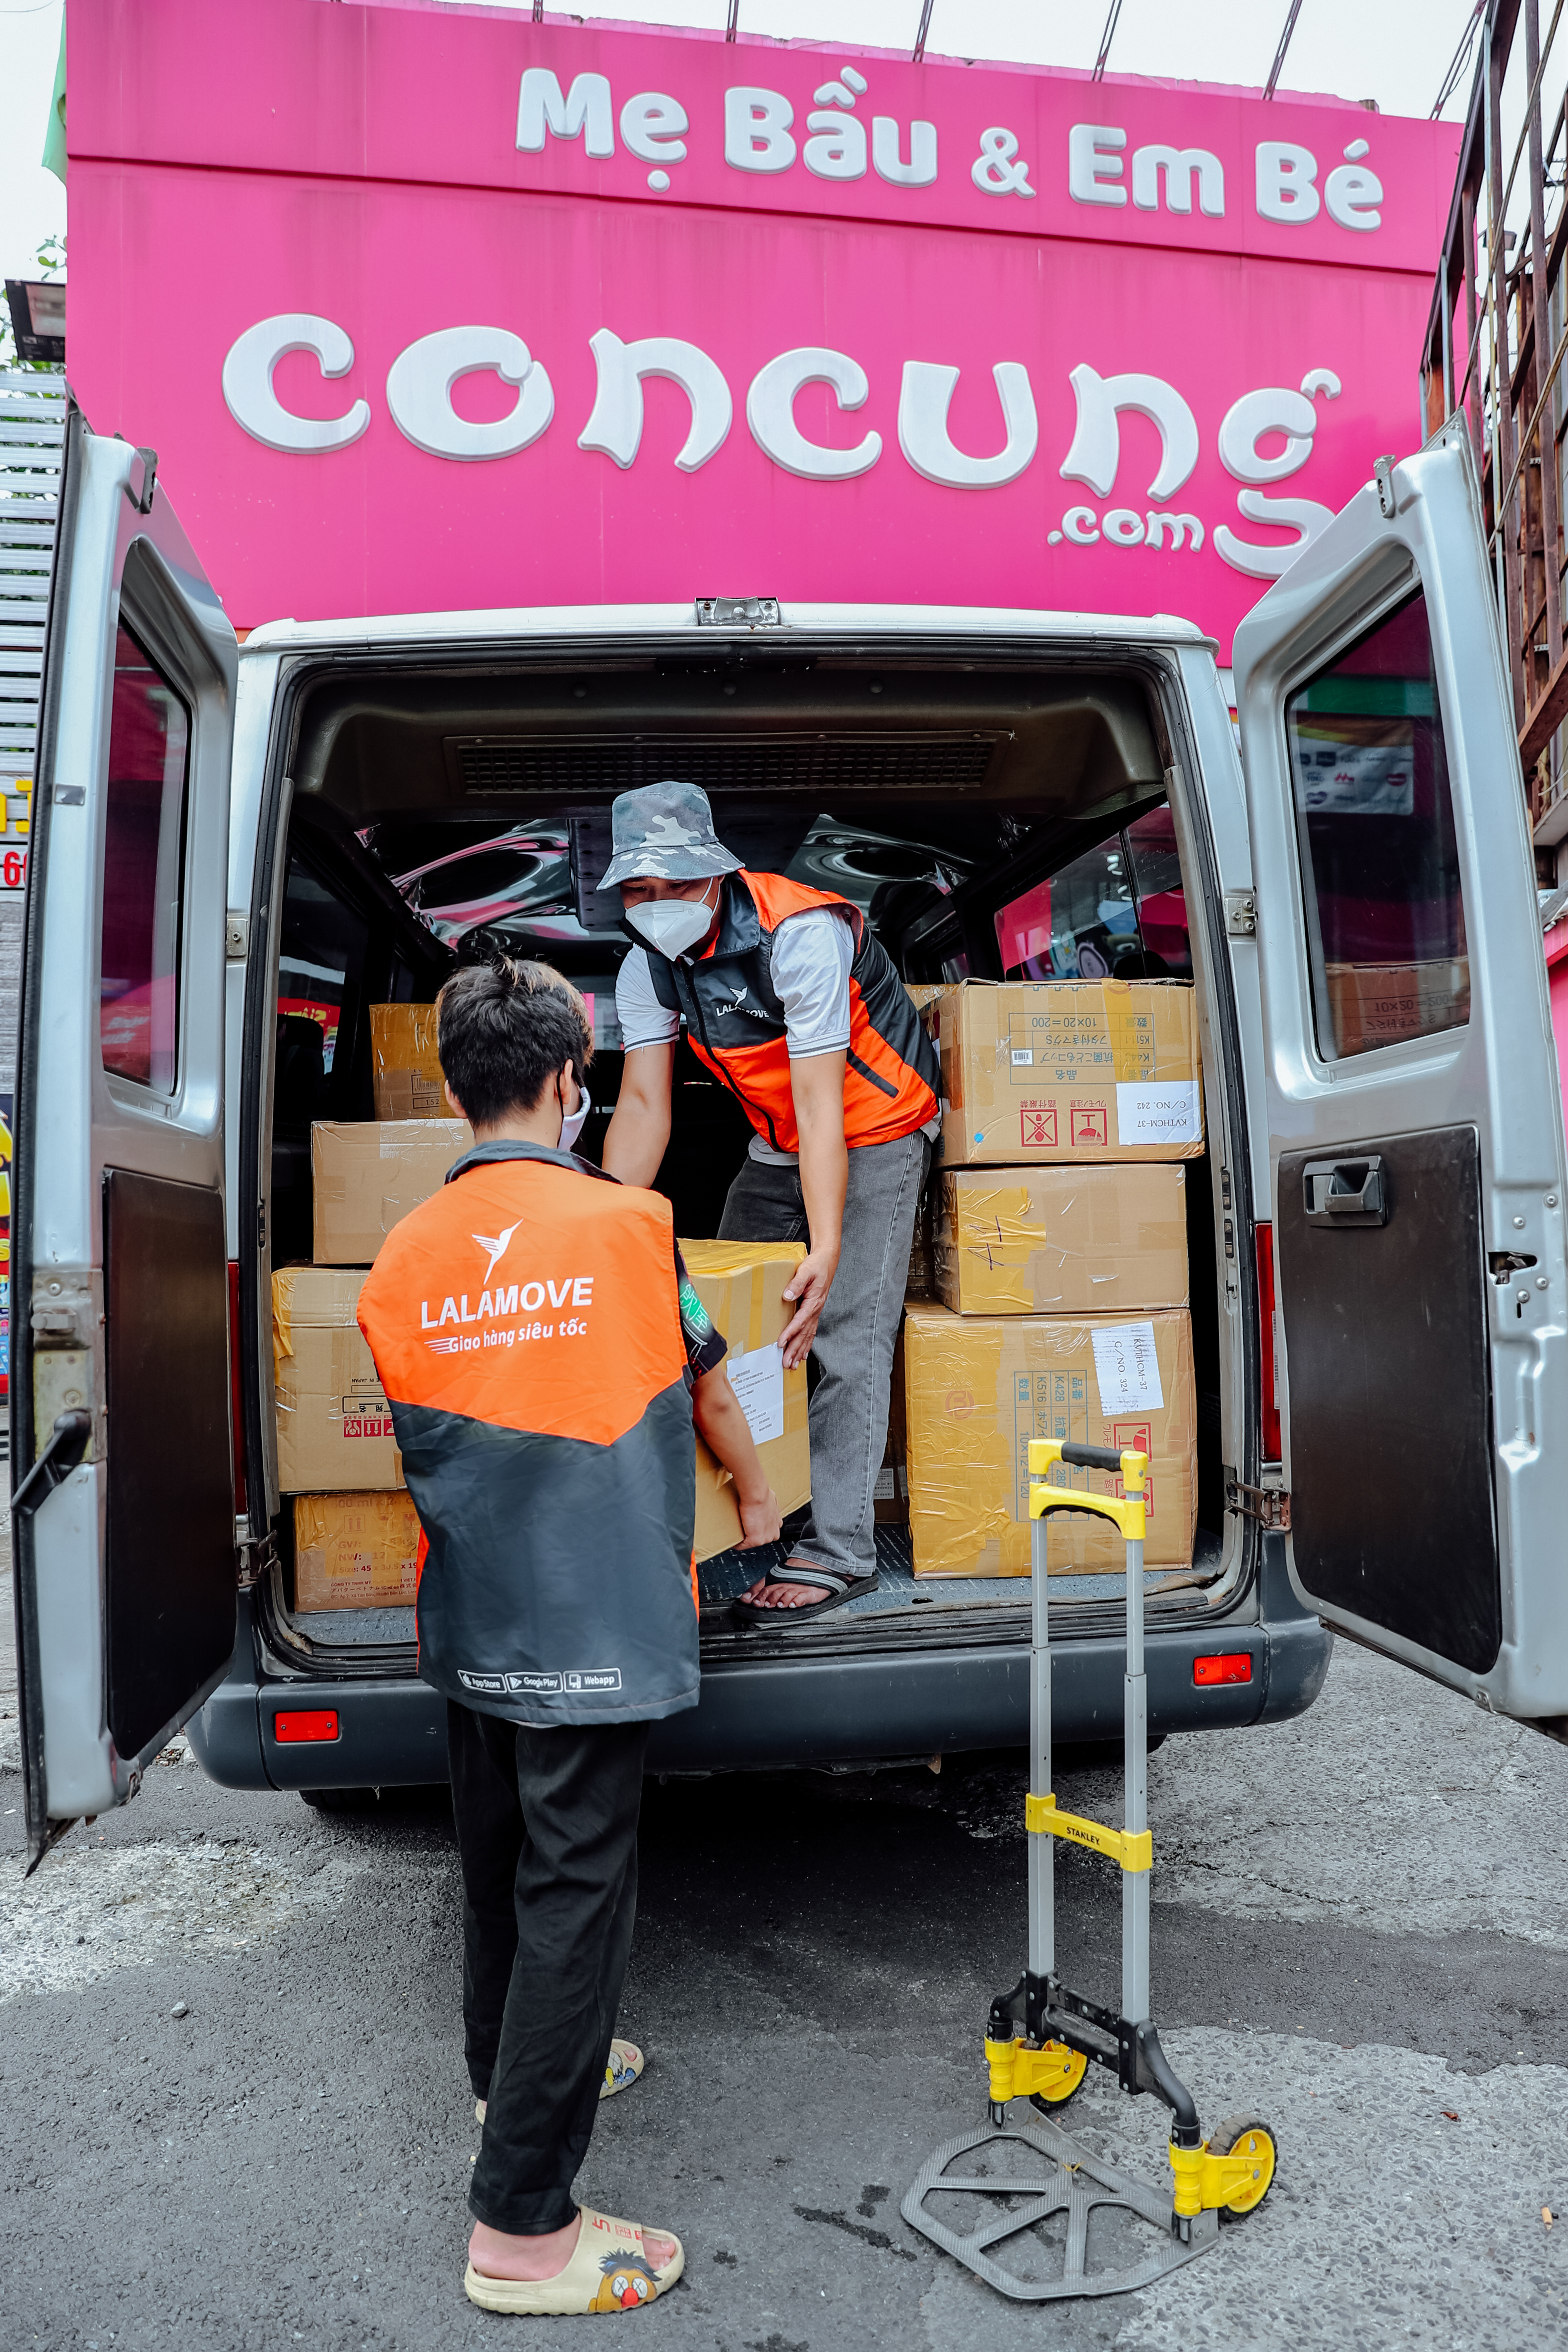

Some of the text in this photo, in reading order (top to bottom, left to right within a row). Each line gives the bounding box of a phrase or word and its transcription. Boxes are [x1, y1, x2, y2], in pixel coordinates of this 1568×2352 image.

[516, 66, 1383, 232] Mẹ Bầu & Em Bé
[223, 313, 1341, 580] concung
[1046, 506, 1203, 552] .com
[3, 851, 27, 887] 6
[716, 1004, 769, 1018] LALOVE
[1040, 1052, 1113, 1063] 抗菌こどもコップ
[1055, 1069, 1077, 1080] 品名
[1127, 1069, 1149, 1081] 品番
[1020, 1099, 1057, 1108] 踏付厳禁
[1069, 1099, 1106, 1108] ワレモノ注意
[1137, 1102, 1151, 1110] 242
[1137, 1118, 1188, 1128] KVTHCM-37
[421, 1277, 594, 1329] LALAMOVE
[448, 1318, 587, 1353] Giao hàng siêu tốc
[1134, 1337, 1148, 1391] KVTHCM-37
[1018, 1378, 1029, 1402] 数量
[1037, 1376, 1047, 1402] K516
[1055, 1376, 1065, 1402] K428
[1071, 1377, 1084, 1400] 品番
[1120, 1378, 1129, 1393] 324
[1036, 1410, 1048, 1438] ホワイ
[339, 1553, 362, 1561] NW:
[523, 1676, 558, 1688] Google Play
[584, 1675, 615, 1686] Webapp
[1067, 1826, 1100, 1845] STANLEY
